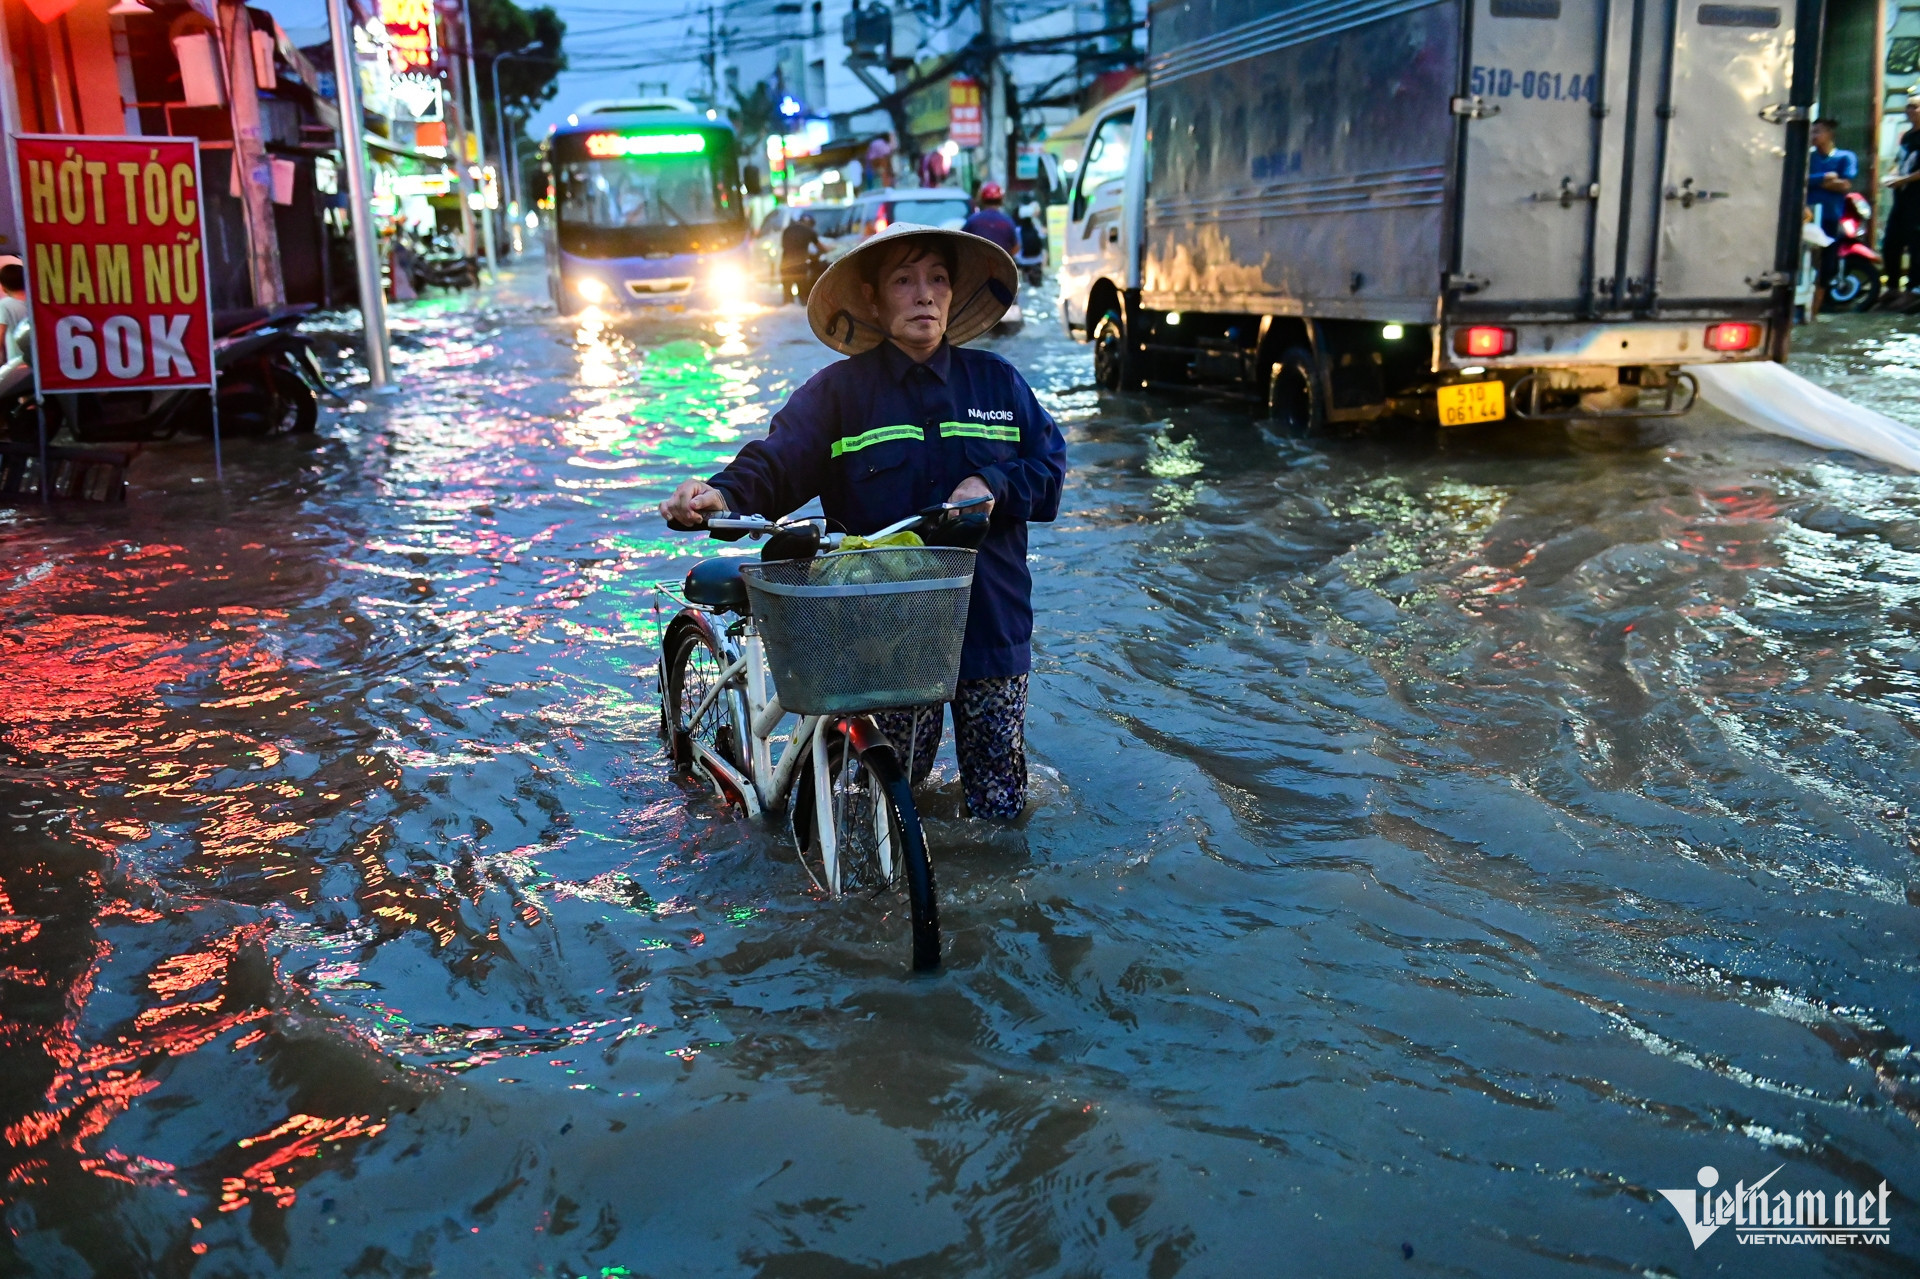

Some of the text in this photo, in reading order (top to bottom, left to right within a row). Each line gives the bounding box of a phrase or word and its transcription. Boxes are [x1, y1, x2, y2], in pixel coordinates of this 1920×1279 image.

[28, 146, 196, 226] HỚT TÓC
[35, 231, 200, 305] NAM NỮ
[55, 314, 197, 381] 60K
